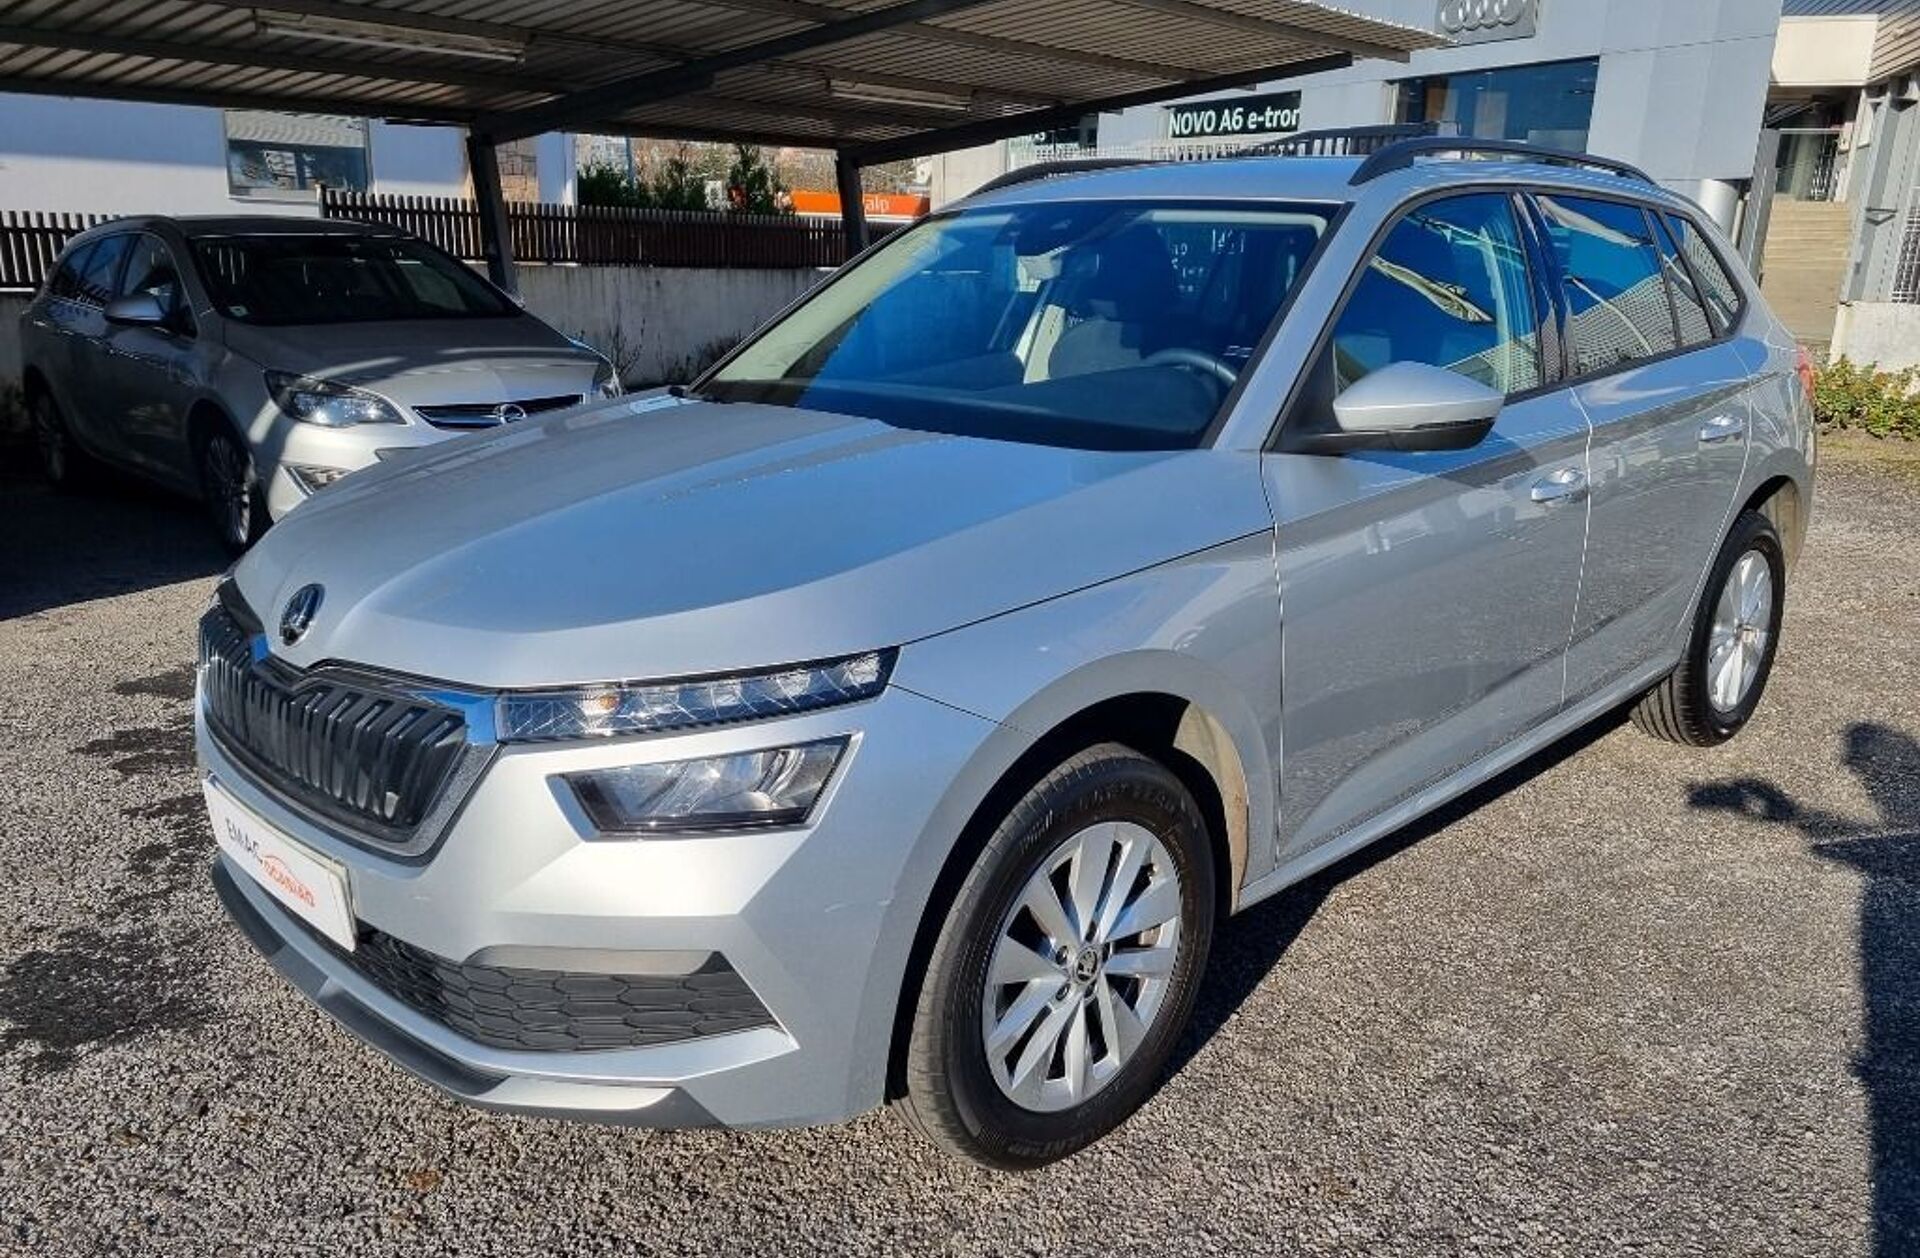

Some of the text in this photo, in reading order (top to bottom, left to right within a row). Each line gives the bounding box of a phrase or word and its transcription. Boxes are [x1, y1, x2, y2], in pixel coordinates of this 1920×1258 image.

[1168, 109, 1216, 136] NOVO
[1219, 102, 1244, 131] A6
[865, 194, 890, 214] alp
